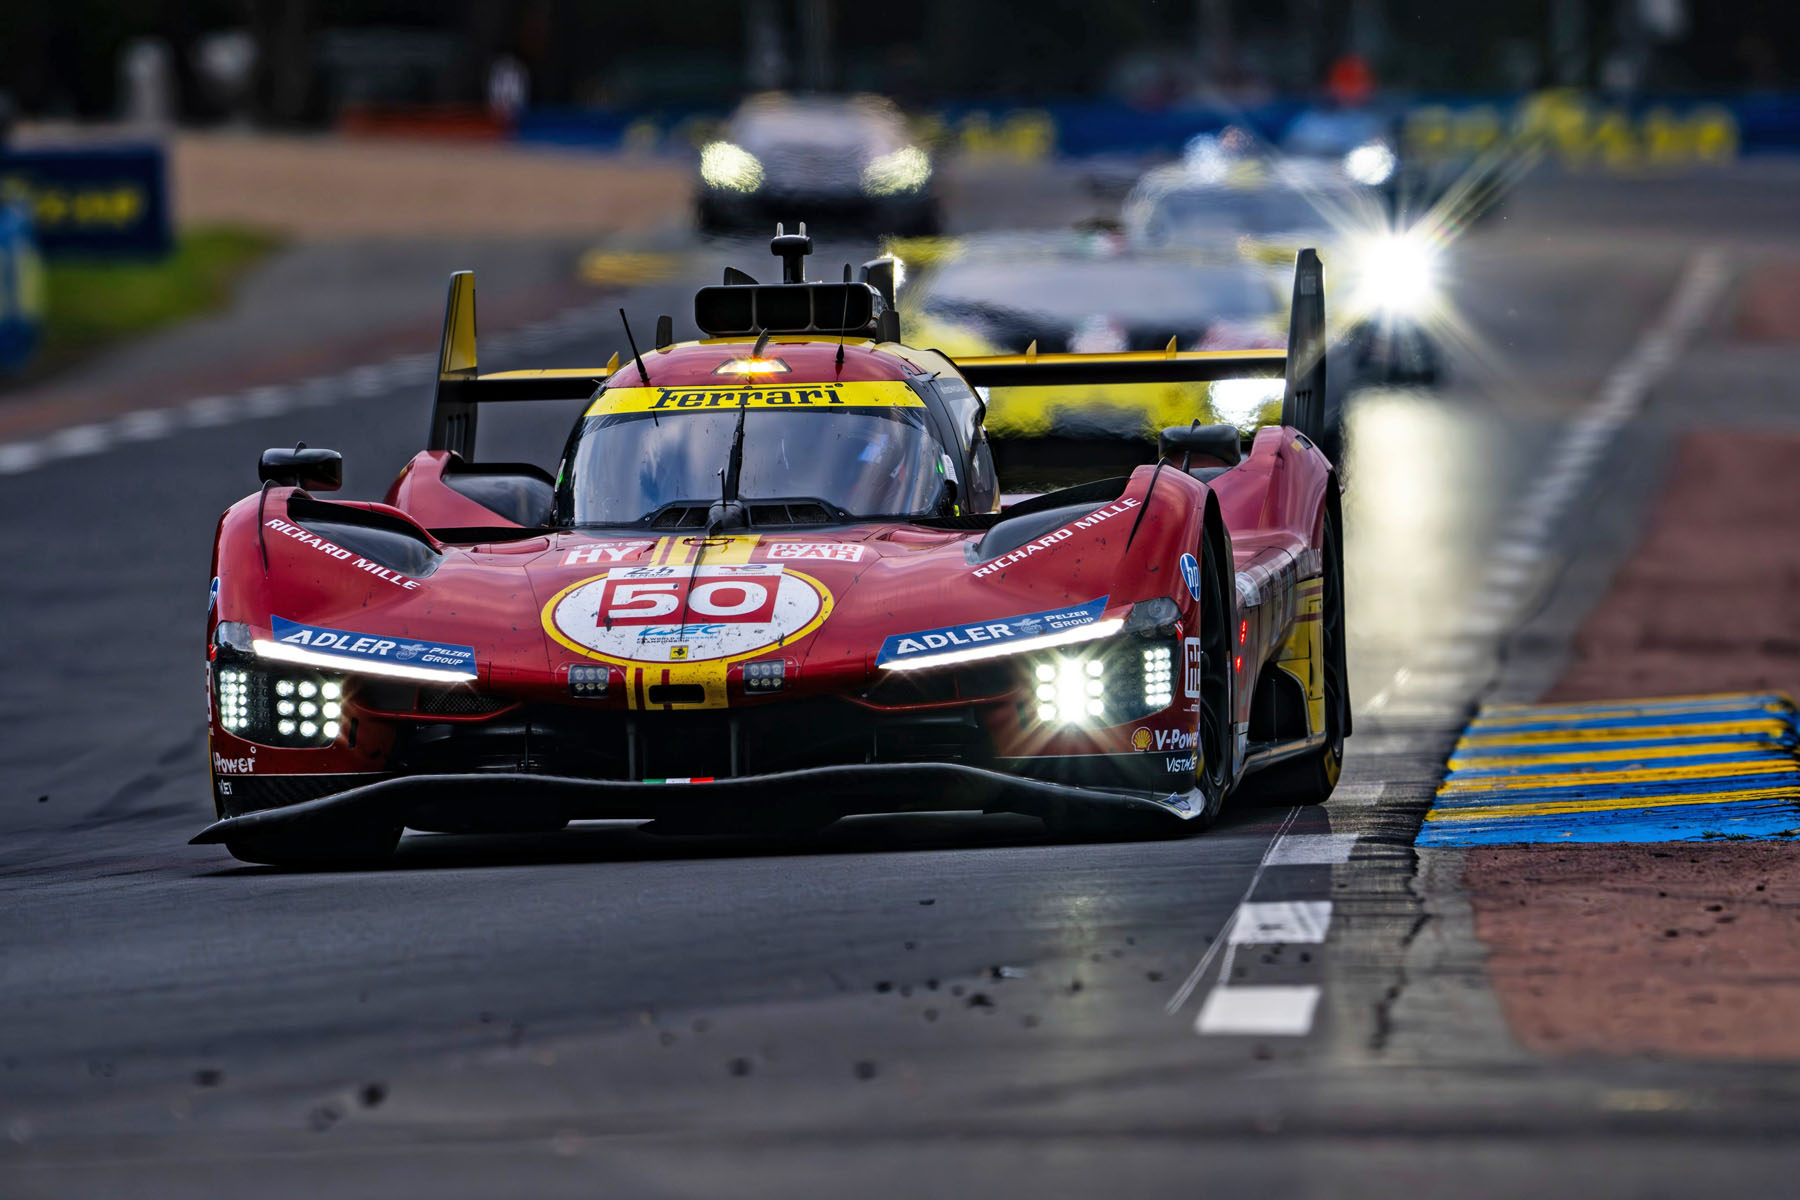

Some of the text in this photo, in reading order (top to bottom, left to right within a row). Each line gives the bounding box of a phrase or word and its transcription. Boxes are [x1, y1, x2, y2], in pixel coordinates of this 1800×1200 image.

[648, 382, 844, 409] Ferrari
[972, 497, 1141, 578] RICHARD MILLE
[264, 518, 421, 590] RICHARD MILLE
[565, 547, 639, 565] HY
[773, 549, 855, 560] CAR
[1183, 555, 1199, 600] hp
[608, 580, 768, 618] 50
[1043, 610, 1089, 622] PELZER
[1050, 616, 1094, 629] GROUP
[638, 624, 726, 637] WEC
[897, 623, 1016, 654] ADLER
[280, 629, 396, 656] ADLER
[429, 647, 472, 658] PELZER
[421, 654, 464, 665] GROUP
